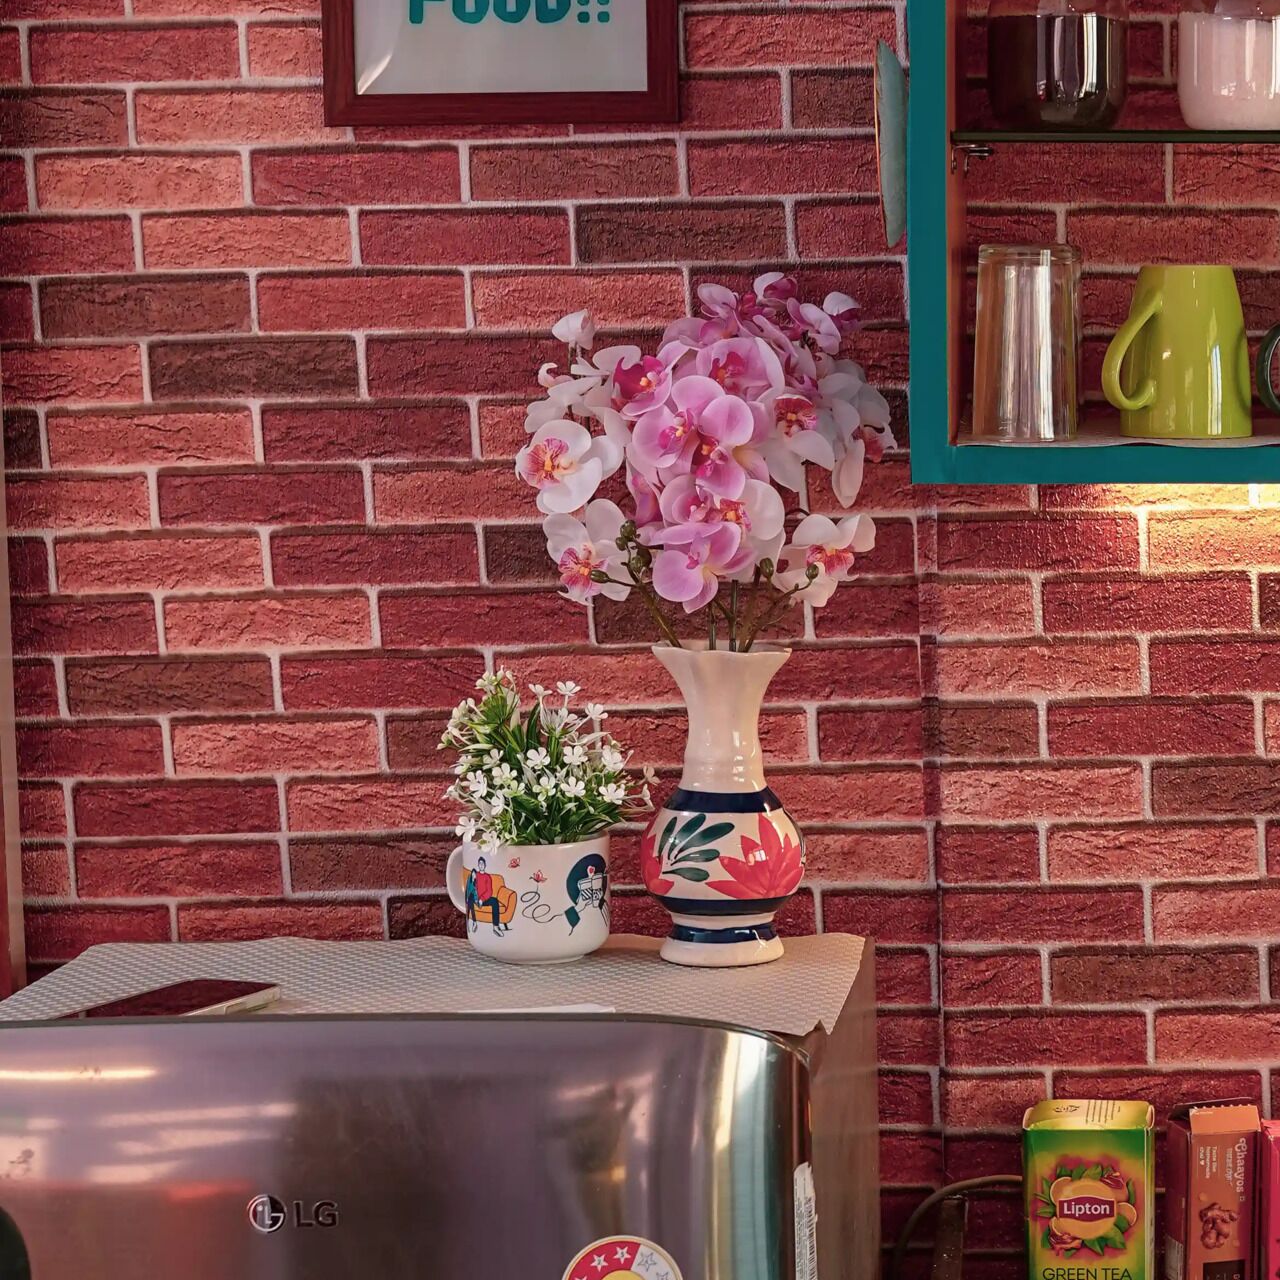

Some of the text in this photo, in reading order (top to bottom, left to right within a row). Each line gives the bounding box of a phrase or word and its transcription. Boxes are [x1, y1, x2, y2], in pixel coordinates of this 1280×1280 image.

[1234, 1137, 1247, 1193] Chaayos
[294, 1200, 340, 1228] LG
[1063, 1201, 1111, 1217] Lipton
[1099, 1267, 1133, 1280] TEA
